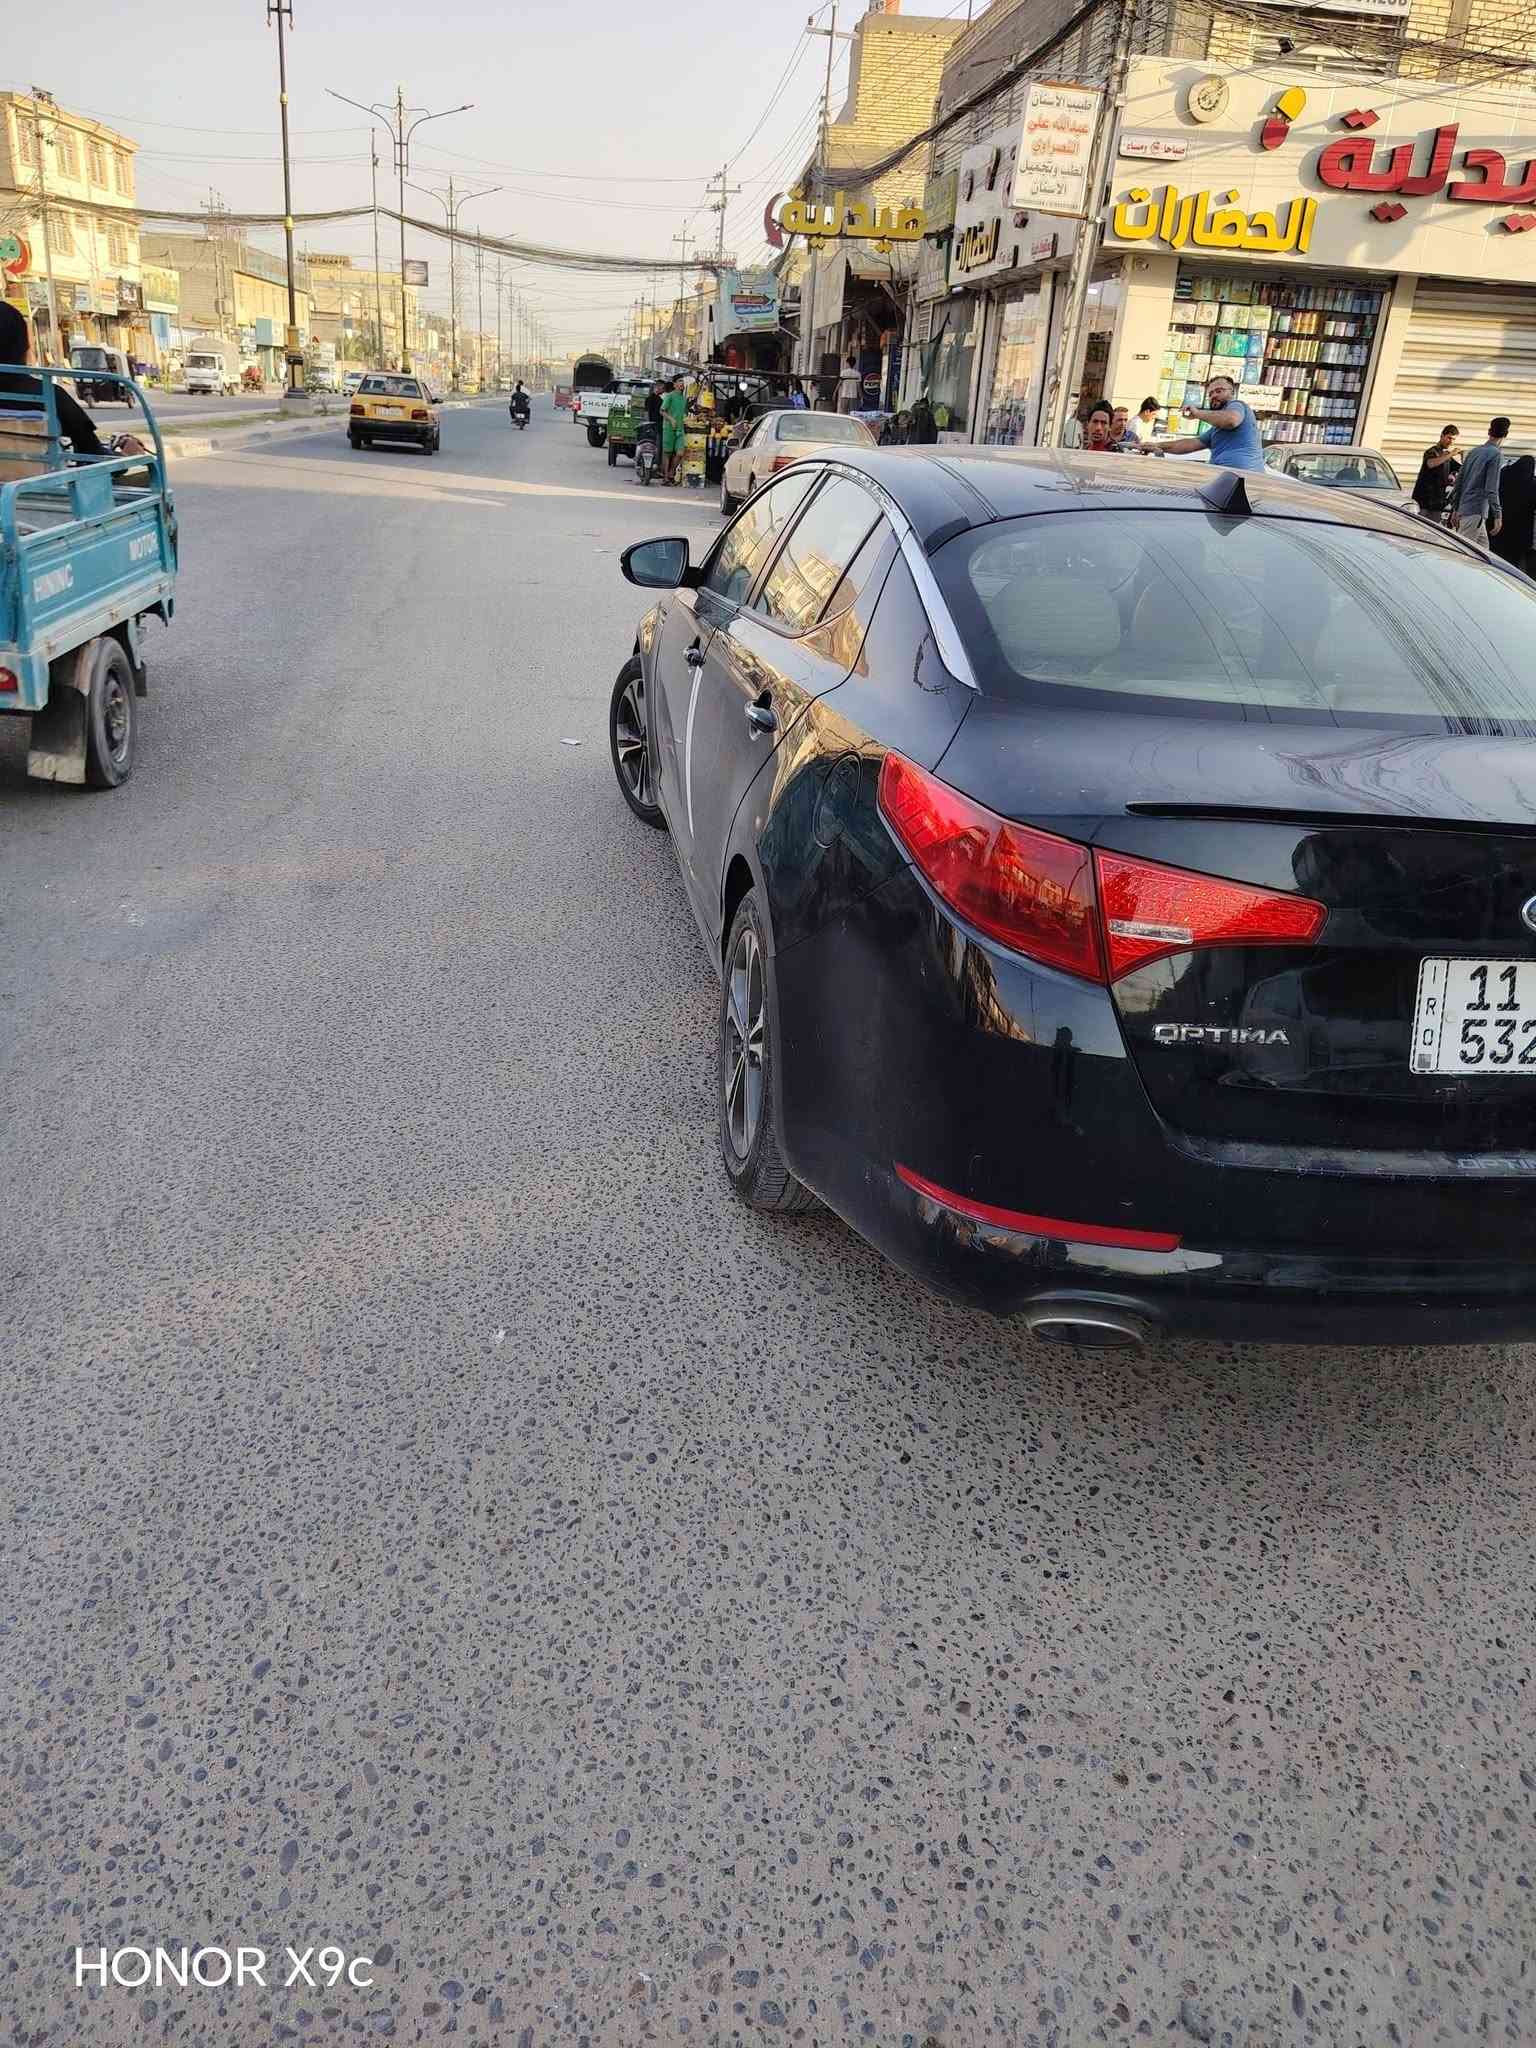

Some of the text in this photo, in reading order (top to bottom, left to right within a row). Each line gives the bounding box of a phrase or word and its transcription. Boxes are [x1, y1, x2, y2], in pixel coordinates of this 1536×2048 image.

[781, 183, 929, 253] صيدلية
[1113, 185, 1318, 253] الحضارات
[1466, 965, 1520, 1011] 11
[1154, 1023, 1290, 1045] OPTIMA
